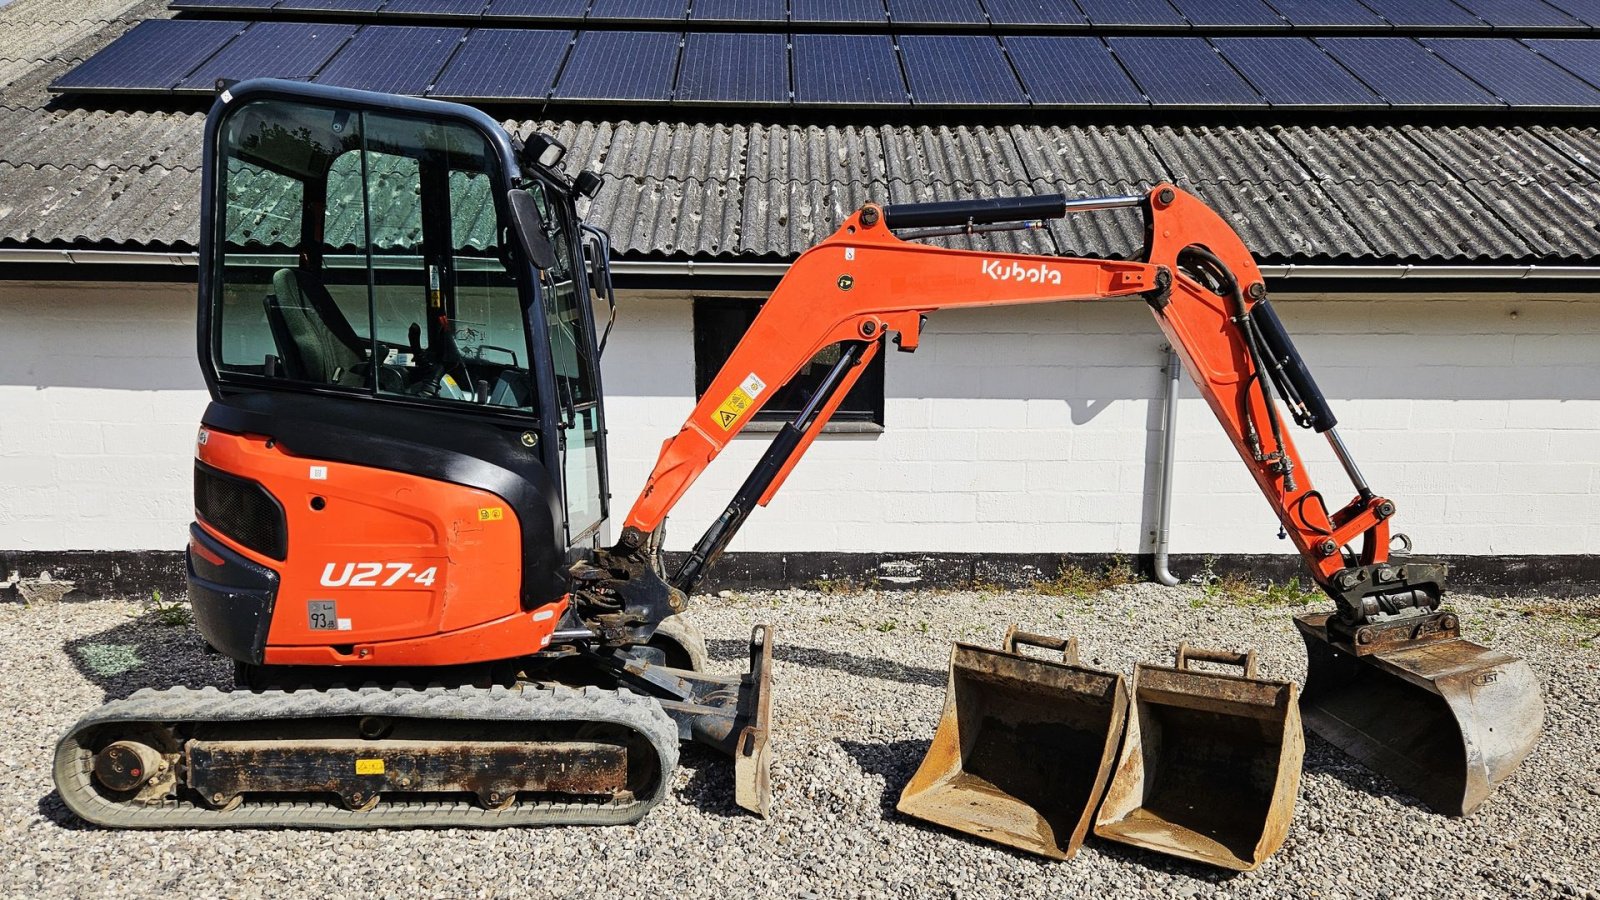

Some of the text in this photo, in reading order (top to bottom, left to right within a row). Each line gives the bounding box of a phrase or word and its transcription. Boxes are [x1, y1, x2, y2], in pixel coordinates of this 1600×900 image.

[981, 259, 1062, 285] Kubota
[320, 562, 438, 587] U27-4
[311, 613, 327, 628] 93
